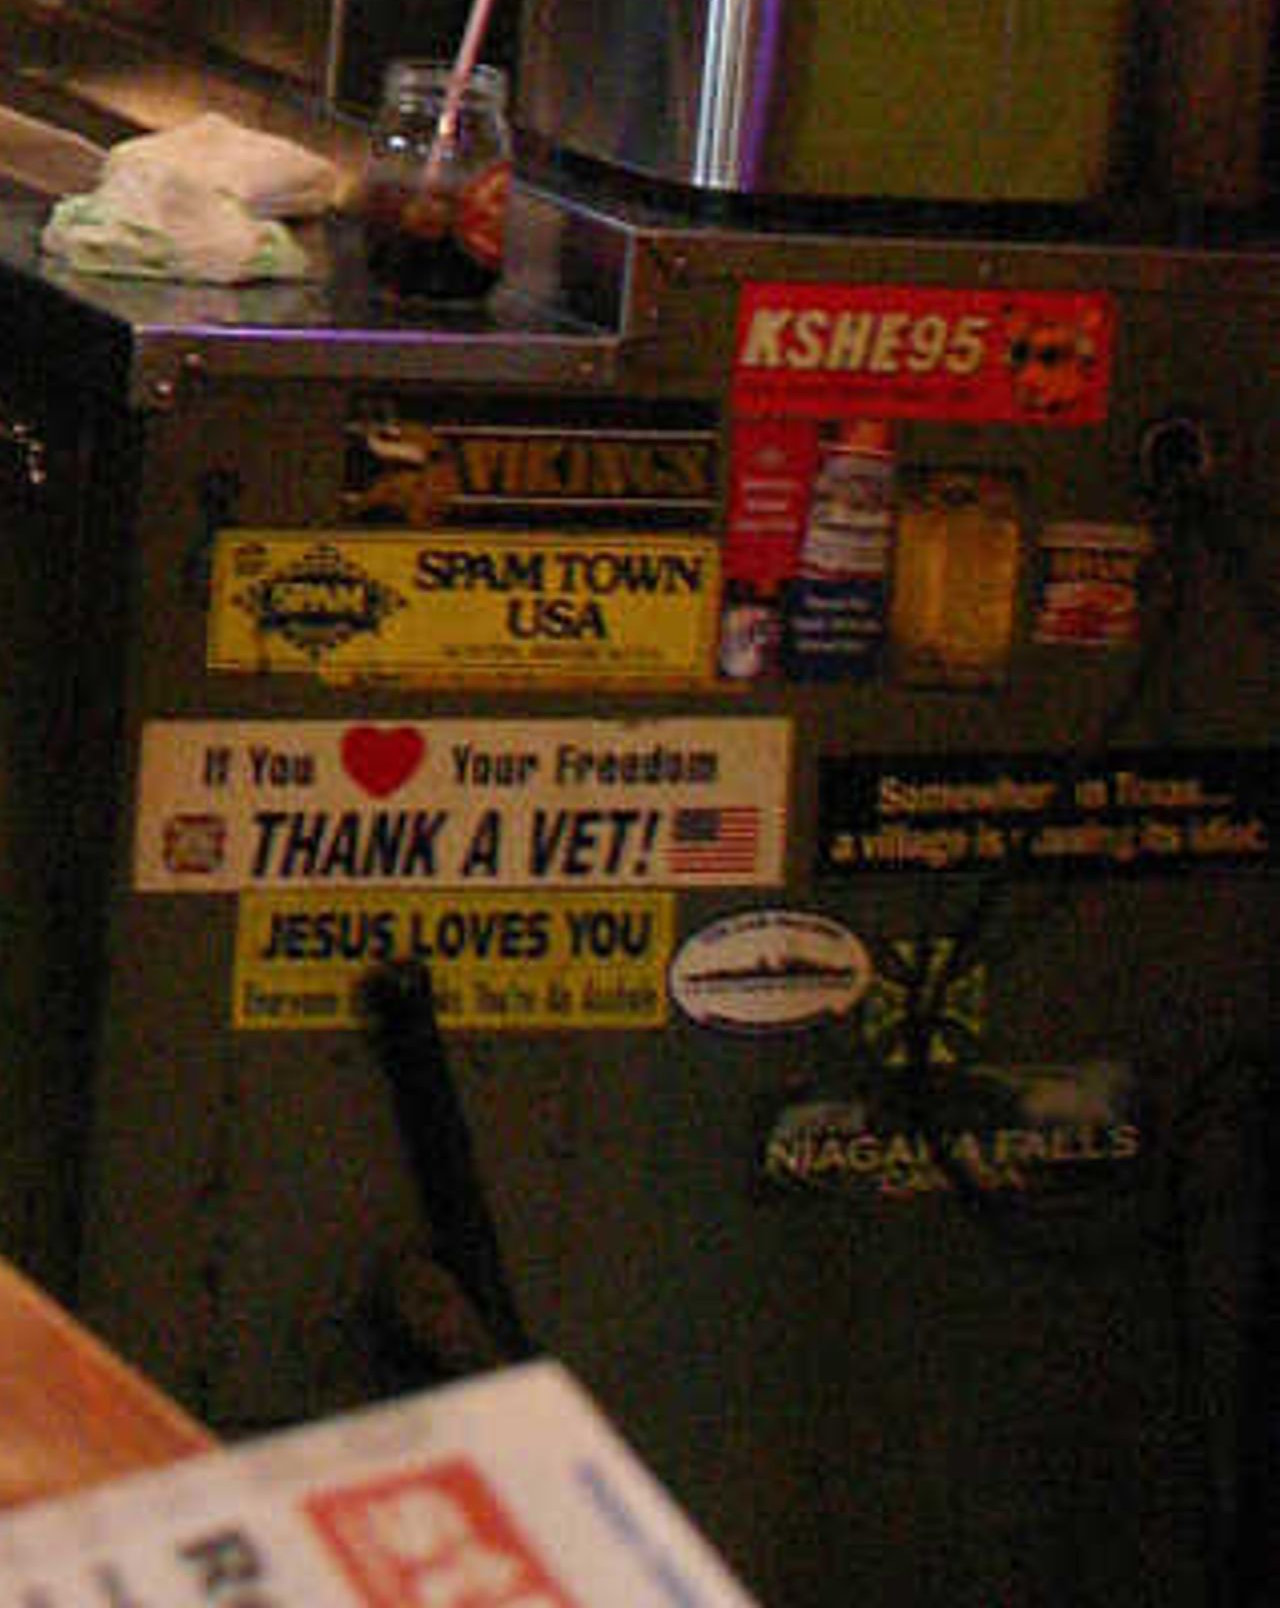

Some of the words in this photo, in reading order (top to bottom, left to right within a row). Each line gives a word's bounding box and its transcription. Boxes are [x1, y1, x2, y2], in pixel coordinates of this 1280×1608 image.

[740, 308, 990, 373] KSHE95
[416, 548, 550, 592] SPAM
[552, 550, 705, 594] TOWN
[506, 596, 608, 640] USA
[249, 745, 315, 787] You
[453, 744, 538, 787] Your
[557, 743, 721, 785] Freedom
[249, 808, 447, 879] THANK
[462, 808, 505, 878] A
[528, 806, 661, 878] VET!
[261, 910, 398, 961] JESUS
[412, 910, 550, 960] LOVES
[566, 909, 654, 959] YOU
